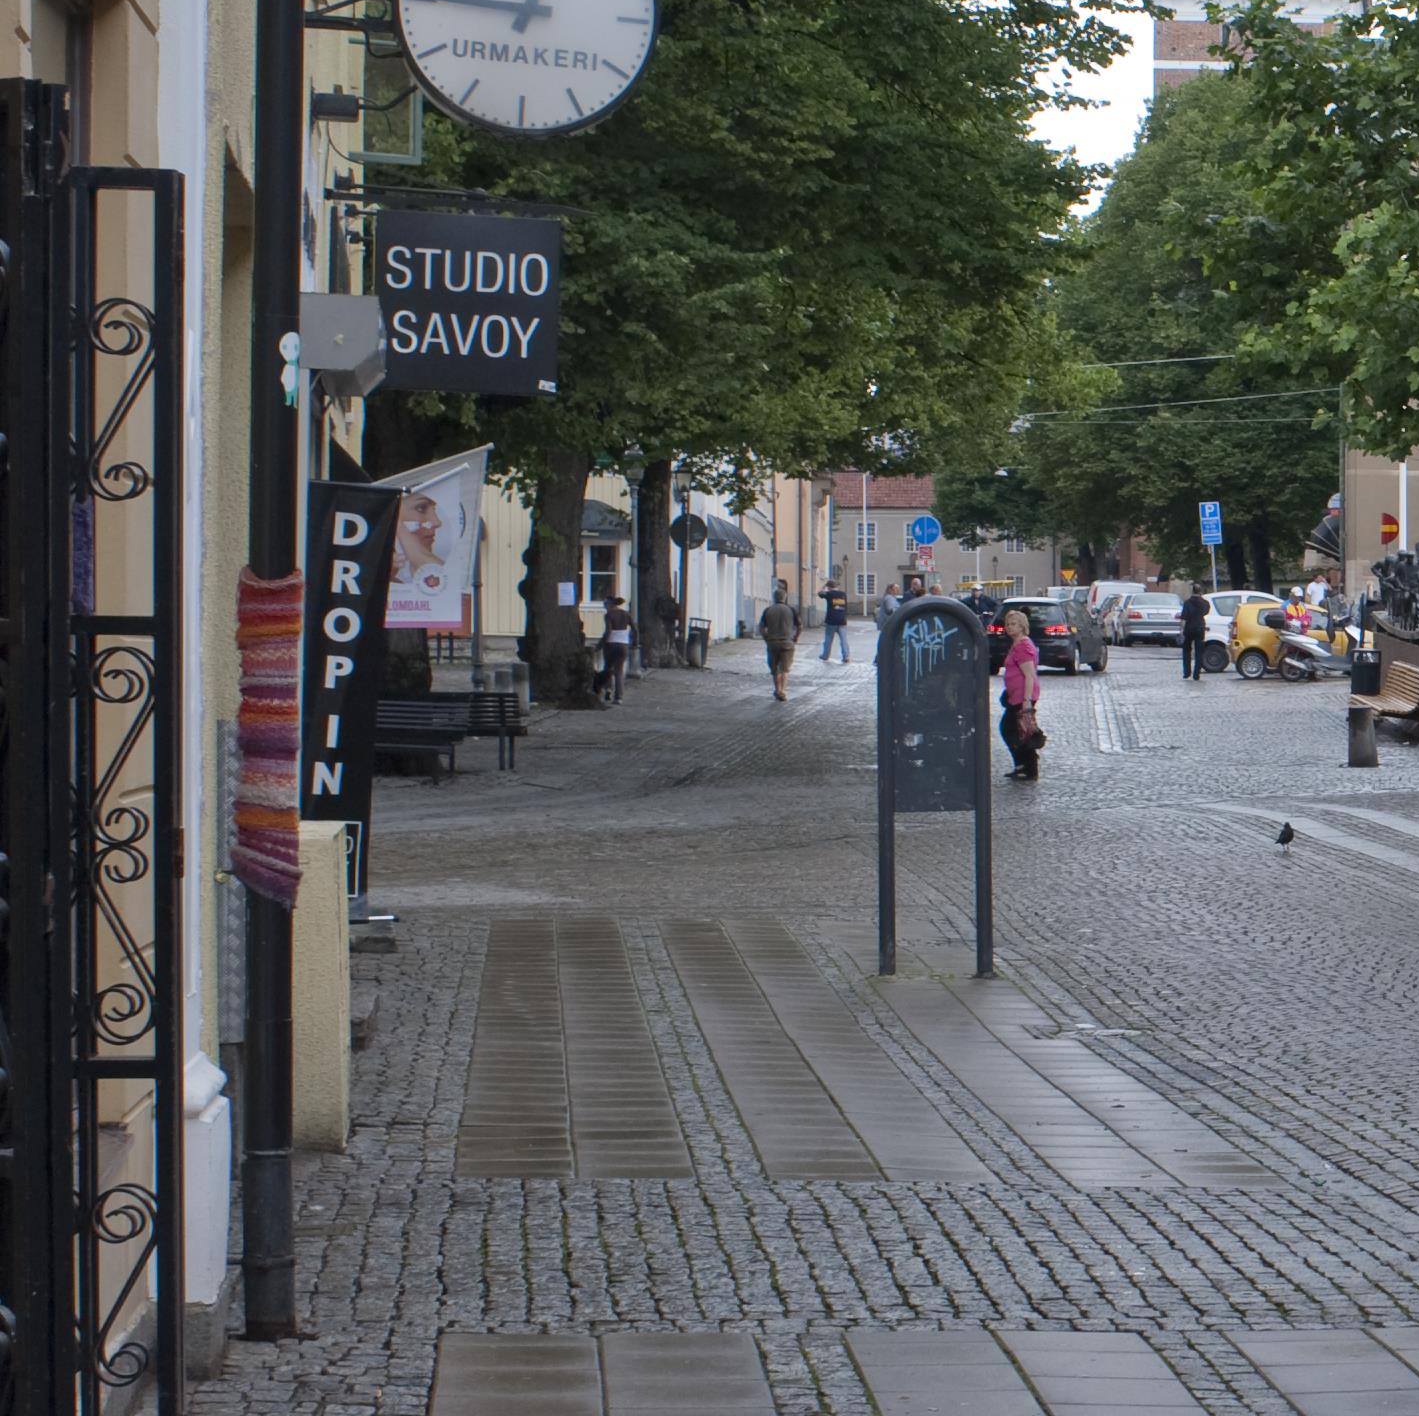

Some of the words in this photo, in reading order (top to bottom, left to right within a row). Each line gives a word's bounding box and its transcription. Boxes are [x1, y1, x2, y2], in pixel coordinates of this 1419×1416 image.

[451, 38, 598, 71] URMAKERI
[385, 245, 550, 297] STUDIO
[391, 310, 541, 359] SAVOY
[322, 512, 368, 690] DROP
[312, 714, 343, 796] IN
